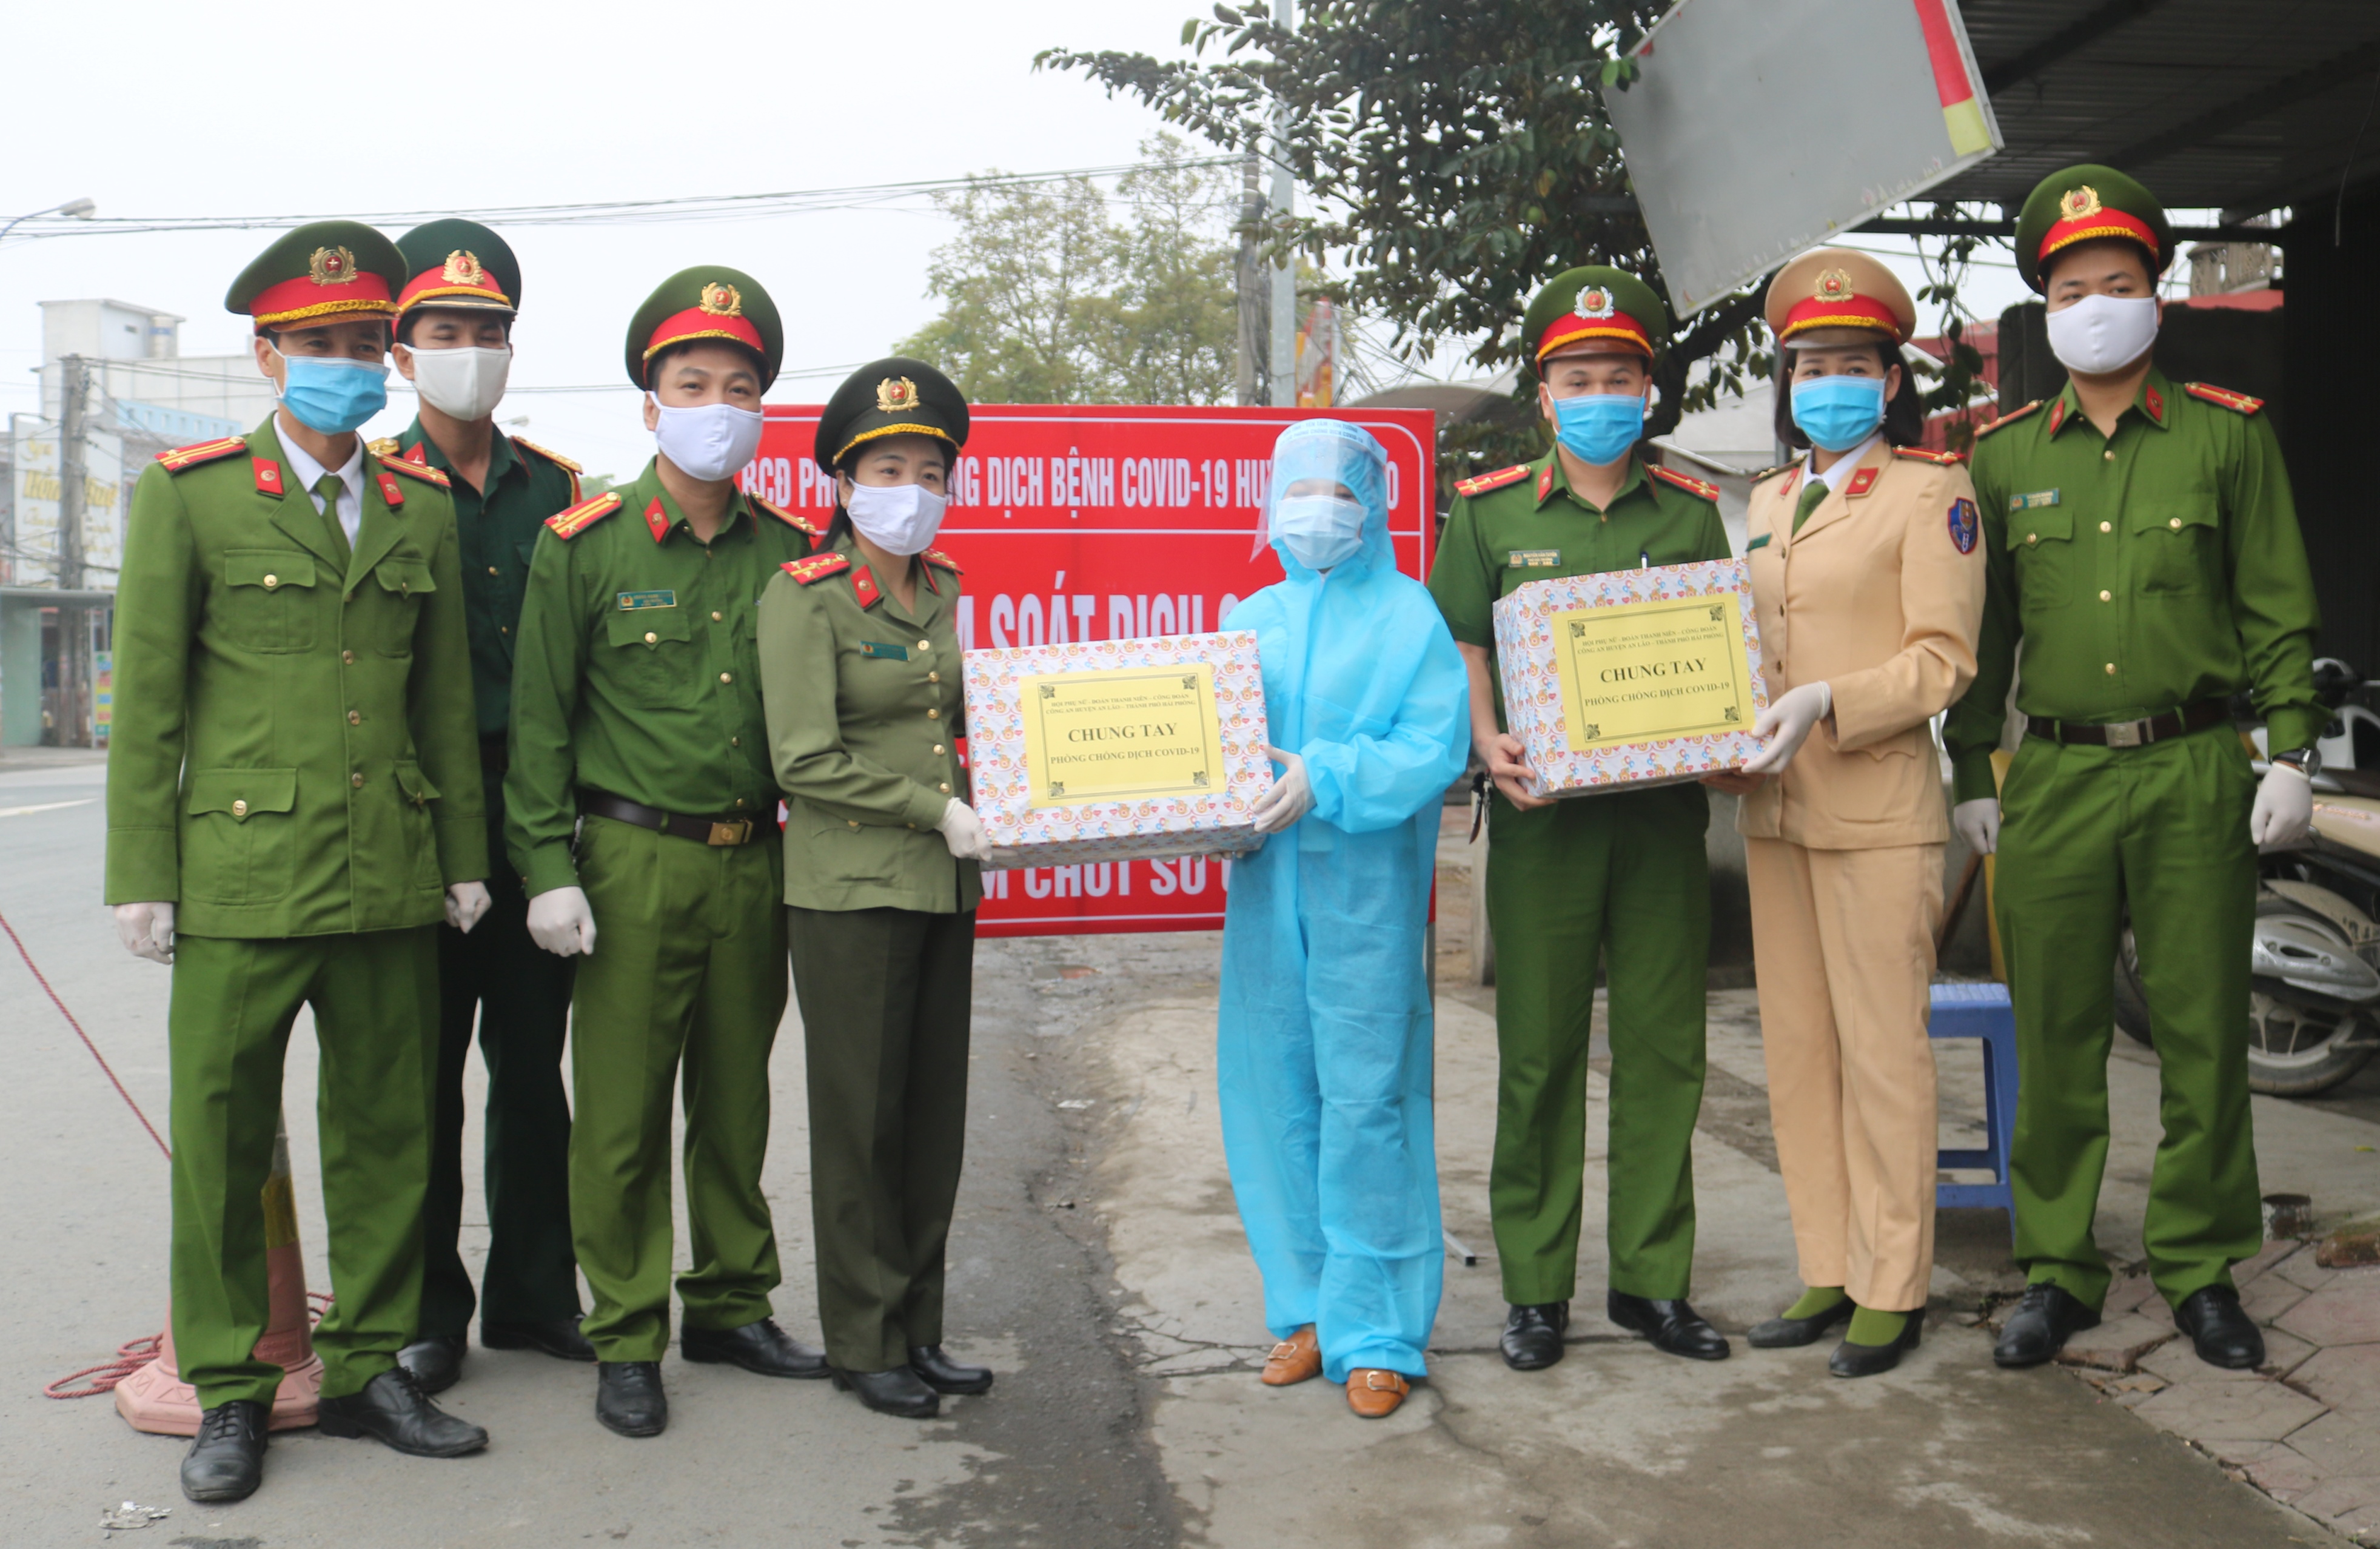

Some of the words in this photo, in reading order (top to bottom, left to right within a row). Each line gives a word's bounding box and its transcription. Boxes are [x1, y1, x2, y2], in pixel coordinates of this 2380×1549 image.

[987, 456, 1044, 519] DỊCH
[1051, 446, 1115, 519] BỆNH
[1122, 457, 1229, 508] COVID-19
[1600, 662, 1666, 683] CHUNG
[1669, 657, 1706, 674] TAY
[1584, 694, 1619, 707] PHÒNG
[1660, 687, 1684, 699] DỊCH
[1686, 681, 1730, 694] COVID-19
[1068, 725, 1135, 742] CHUNG
[1139, 722, 1178, 737] TAY
[1050, 754, 1086, 764] PHÒNG
[1127, 749, 1153, 760] DỊCH
[1155, 746, 1200, 758] COVID-19
